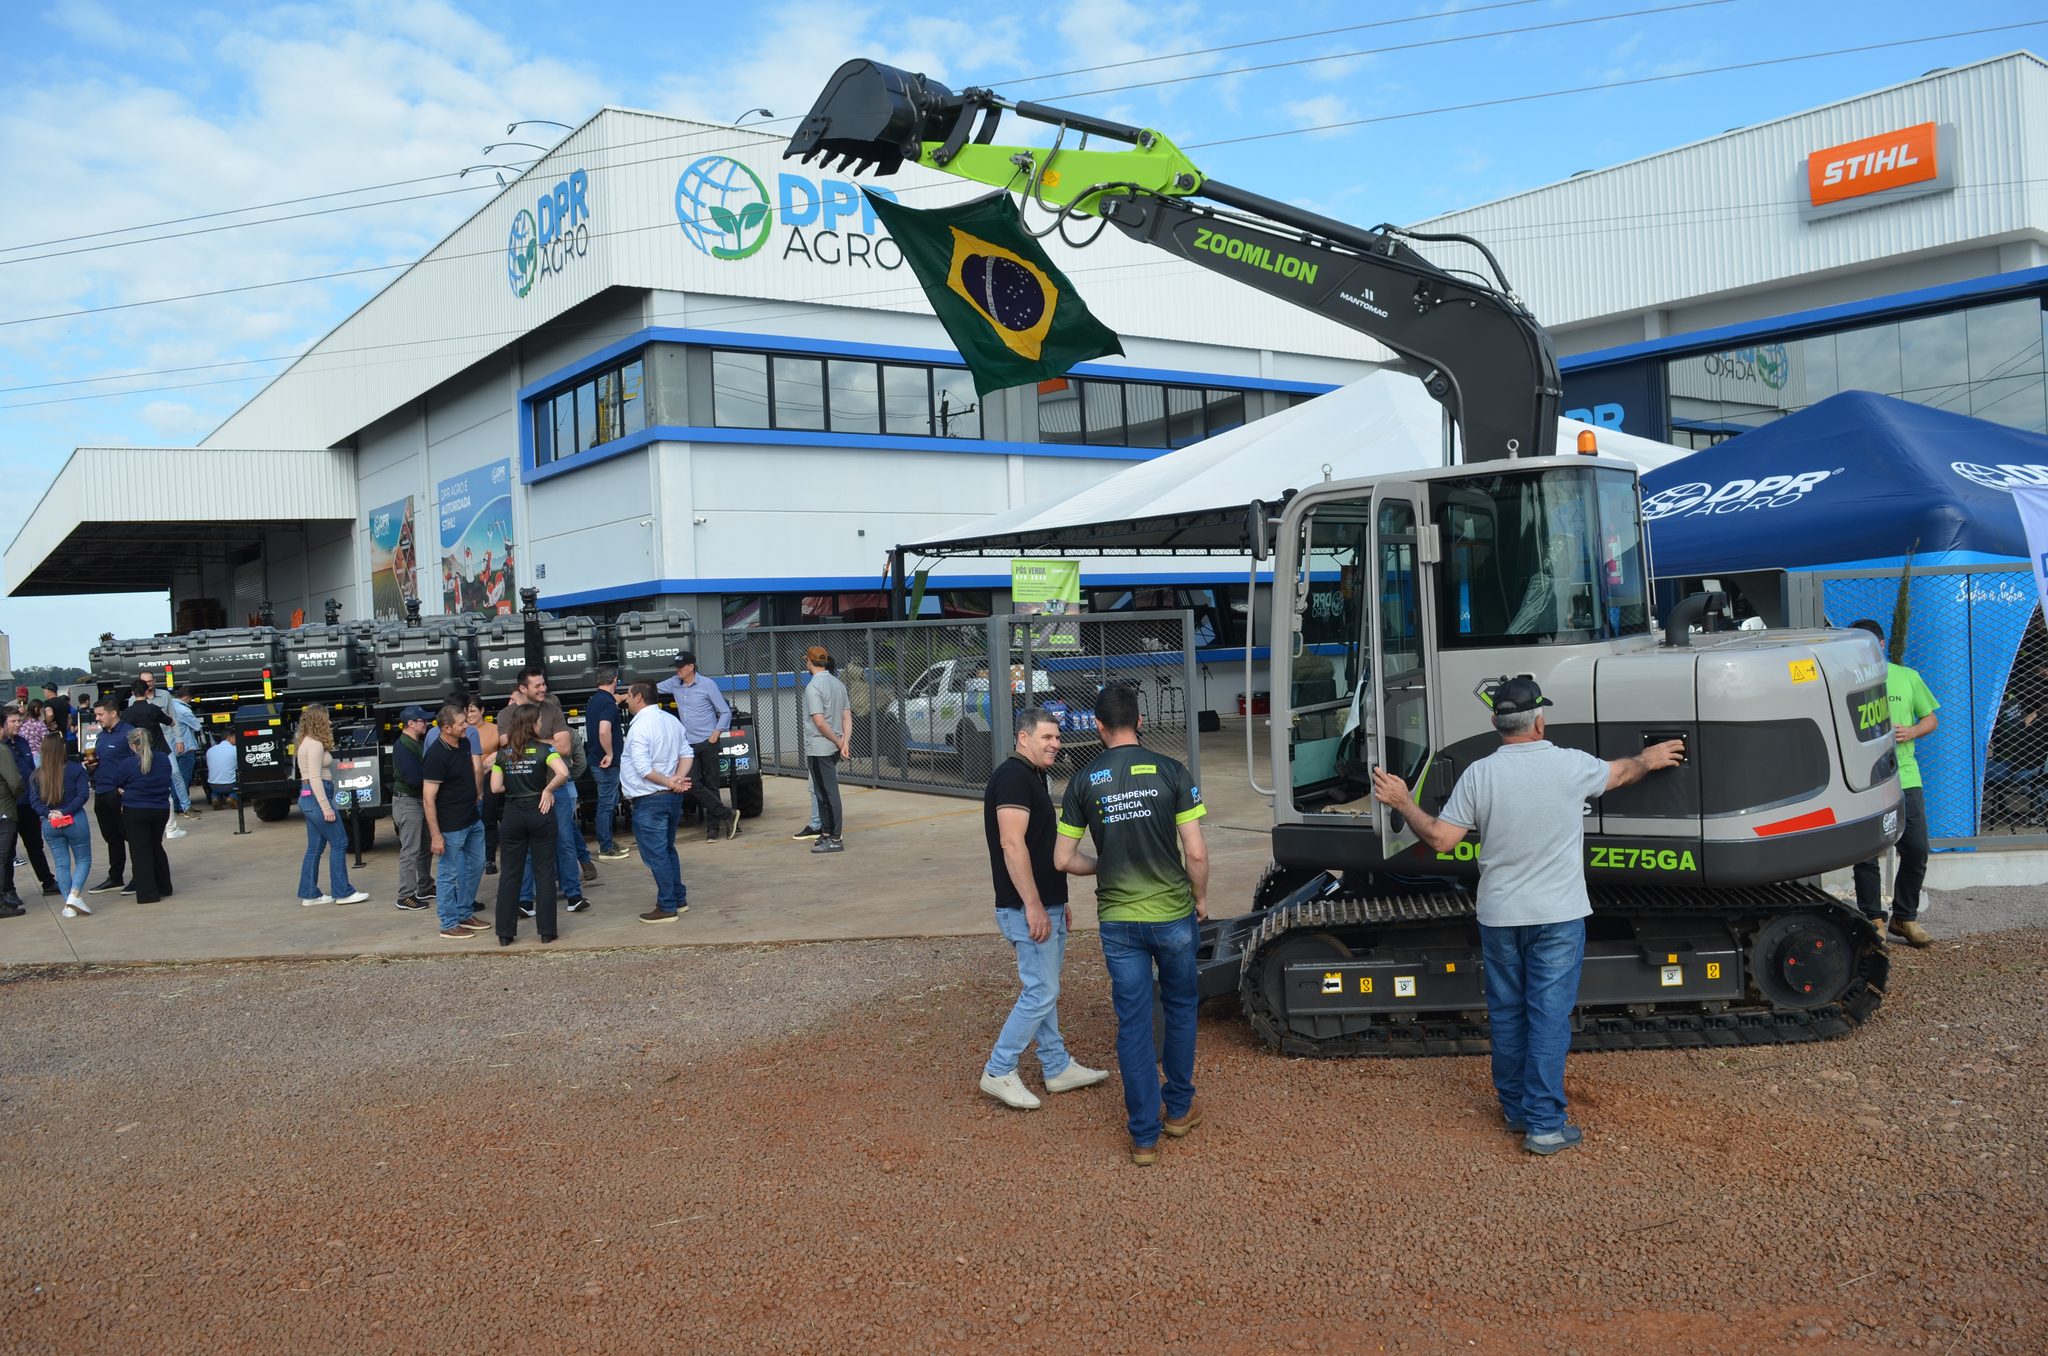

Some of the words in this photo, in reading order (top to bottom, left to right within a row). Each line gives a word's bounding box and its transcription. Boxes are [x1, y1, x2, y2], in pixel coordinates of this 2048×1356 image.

[1823, 144, 1918, 186] STIHL
[537, 168, 590, 248] DPR
[539, 223, 589, 283] AGRO
[782, 226, 904, 271] AGRO
[1193, 227, 1318, 285] ZOOMLION
[1340, 291, 1388, 318] MANTOMAC
[1705, 470, 1831, 503] DPR
[1684, 493, 1803, 517] AGRO
[297, 651, 338, 661] PLANTIO
[301, 659, 336, 668] DIRETO
[549, 653, 587, 664] PLUS
[392, 659, 439, 672] PLANTIO
[396, 668, 437, 679] DIRETO
[255, 752, 271, 761] DPR
[1090, 769, 1110, 782] DPR
[1092, 776, 1112, 787] AGRO
[1101, 789, 1158, 804] DESEMPENHO
[1104, 809, 1151, 824] RESULTADO
[1590, 847, 1697, 871] ZE75GA
